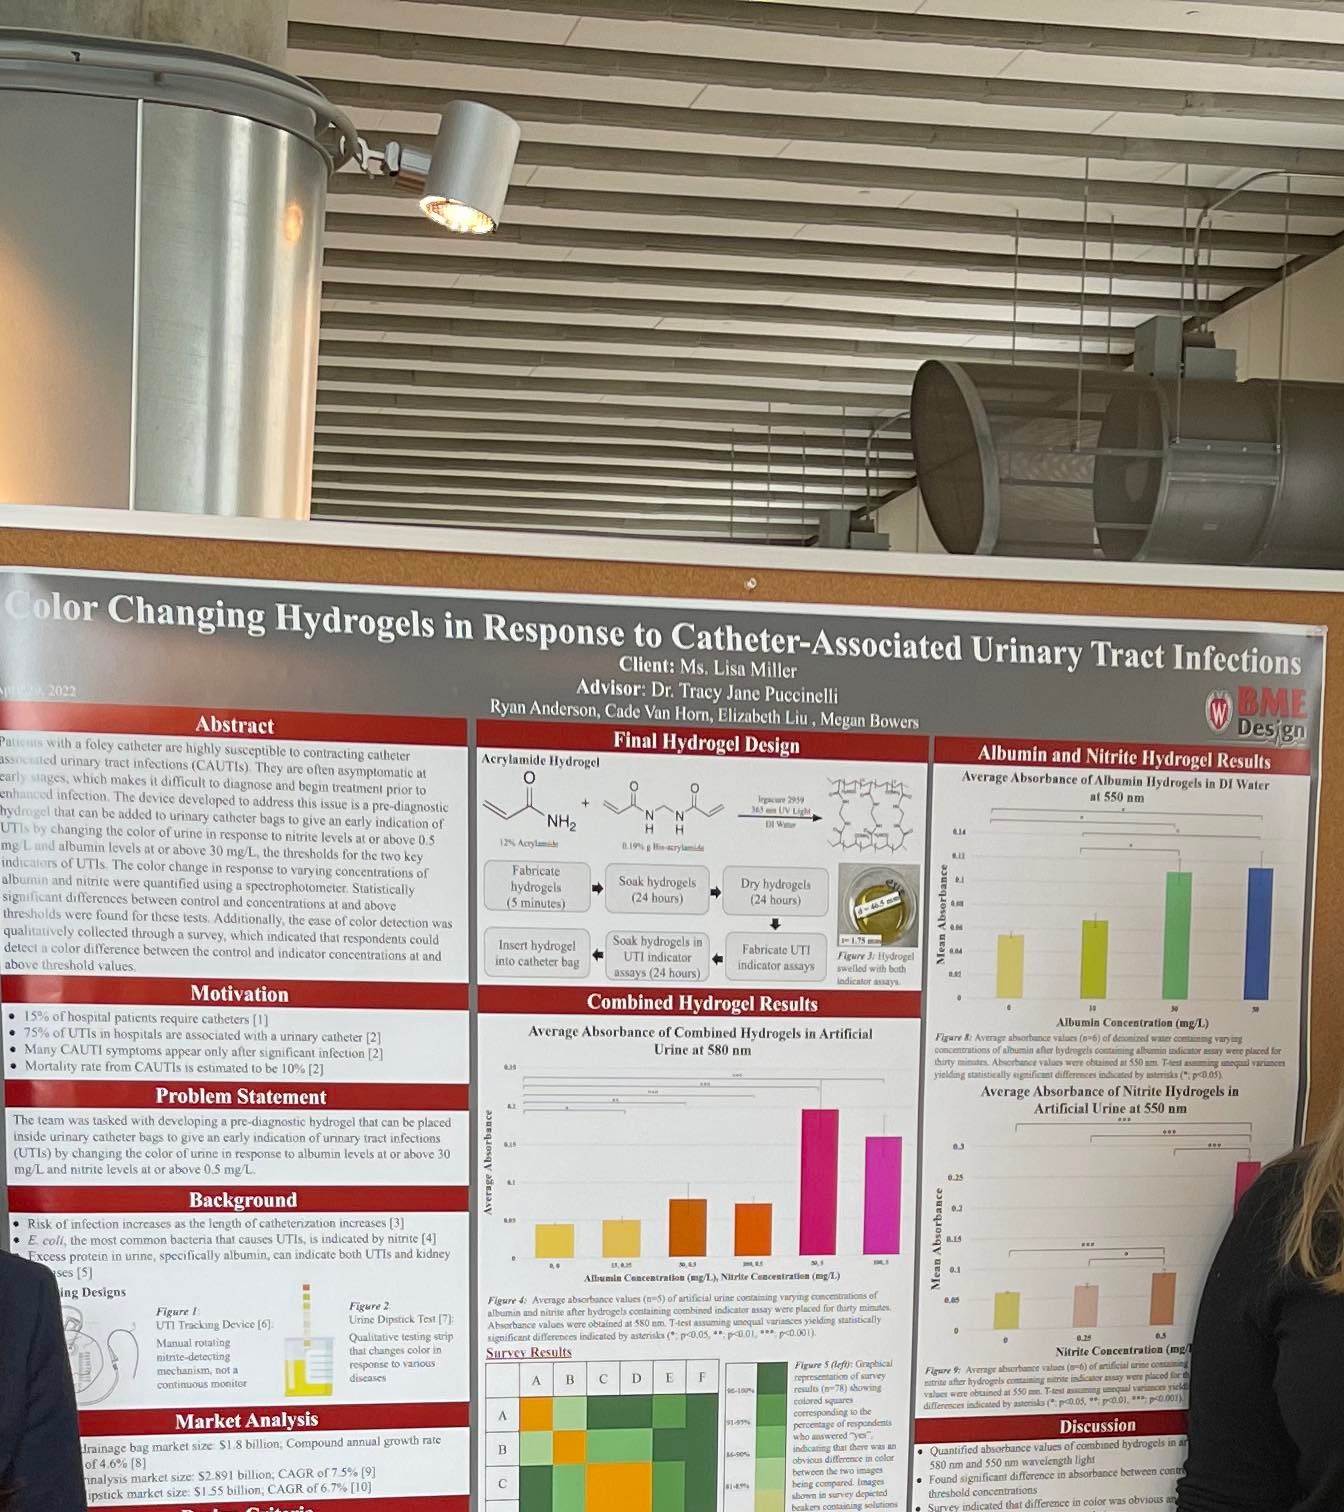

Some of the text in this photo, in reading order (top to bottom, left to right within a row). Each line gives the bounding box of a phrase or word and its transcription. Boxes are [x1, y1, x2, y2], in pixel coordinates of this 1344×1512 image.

[5, 590, 1302, 675] Color Changing Hydrogels in Response to Catheter-Associated Urinary Tract Infections
[619, 656, 797, 678] Client: Ms. Lisa Miller
[576, 679, 837, 703] Advisor: Dr. Tracy Jane Puccinelli
[1237, 686, 1308, 720] BME
[490, 698, 919, 730] Ryan Anderson, Cade Van Horn, Elizabeth Liu Megan Bowers
[195, 715, 277, 734] Abstract
[1238, 718, 1305, 744] Design
[613, 731, 799, 757] Final Hydrogel Design
[480, 753, 600, 769] Acrylamide Hydrogel
[978, 744, 1271, 769] Albumin and Nitrite Hydrogel Results
[510, 864, 562, 876] Fabricate
[508, 880, 563, 895] hydrogels
[740, 877, 811, 892] Dry hydrogels
[504, 896, 567, 912] (5 minutes)
[749, 893, 802, 906] (24 hours)
[498, 939, 576, 953] Insert hydrogel
[494, 956, 580, 970] into catheter bag
[190, 984, 289, 1002] Motivation
[586, 993, 818, 1014] Combined Hydrogel Results
[22, 1010, 268, 1027] 15% of hospital patients require catheters [1]
[527, 1025, 872, 1041] Average Absorbance of Combined Hydrogels in Artificial
[654, 1043, 751, 1055] Urine at 580 nm
[156, 1087, 326, 1104] Problem Statement
[188, 1191, 298, 1211] Background
[25, 1217, 404, 1231] Risk of infection increases as the length of catheterization increases [3]
[485, 1346, 572, 1360] Survey Results
[531, 1372, 706, 1386] A B C D E F
[175, 1411, 318, 1430] Market Analysis
[1059, 1418, 1137, 1433] Discussion
